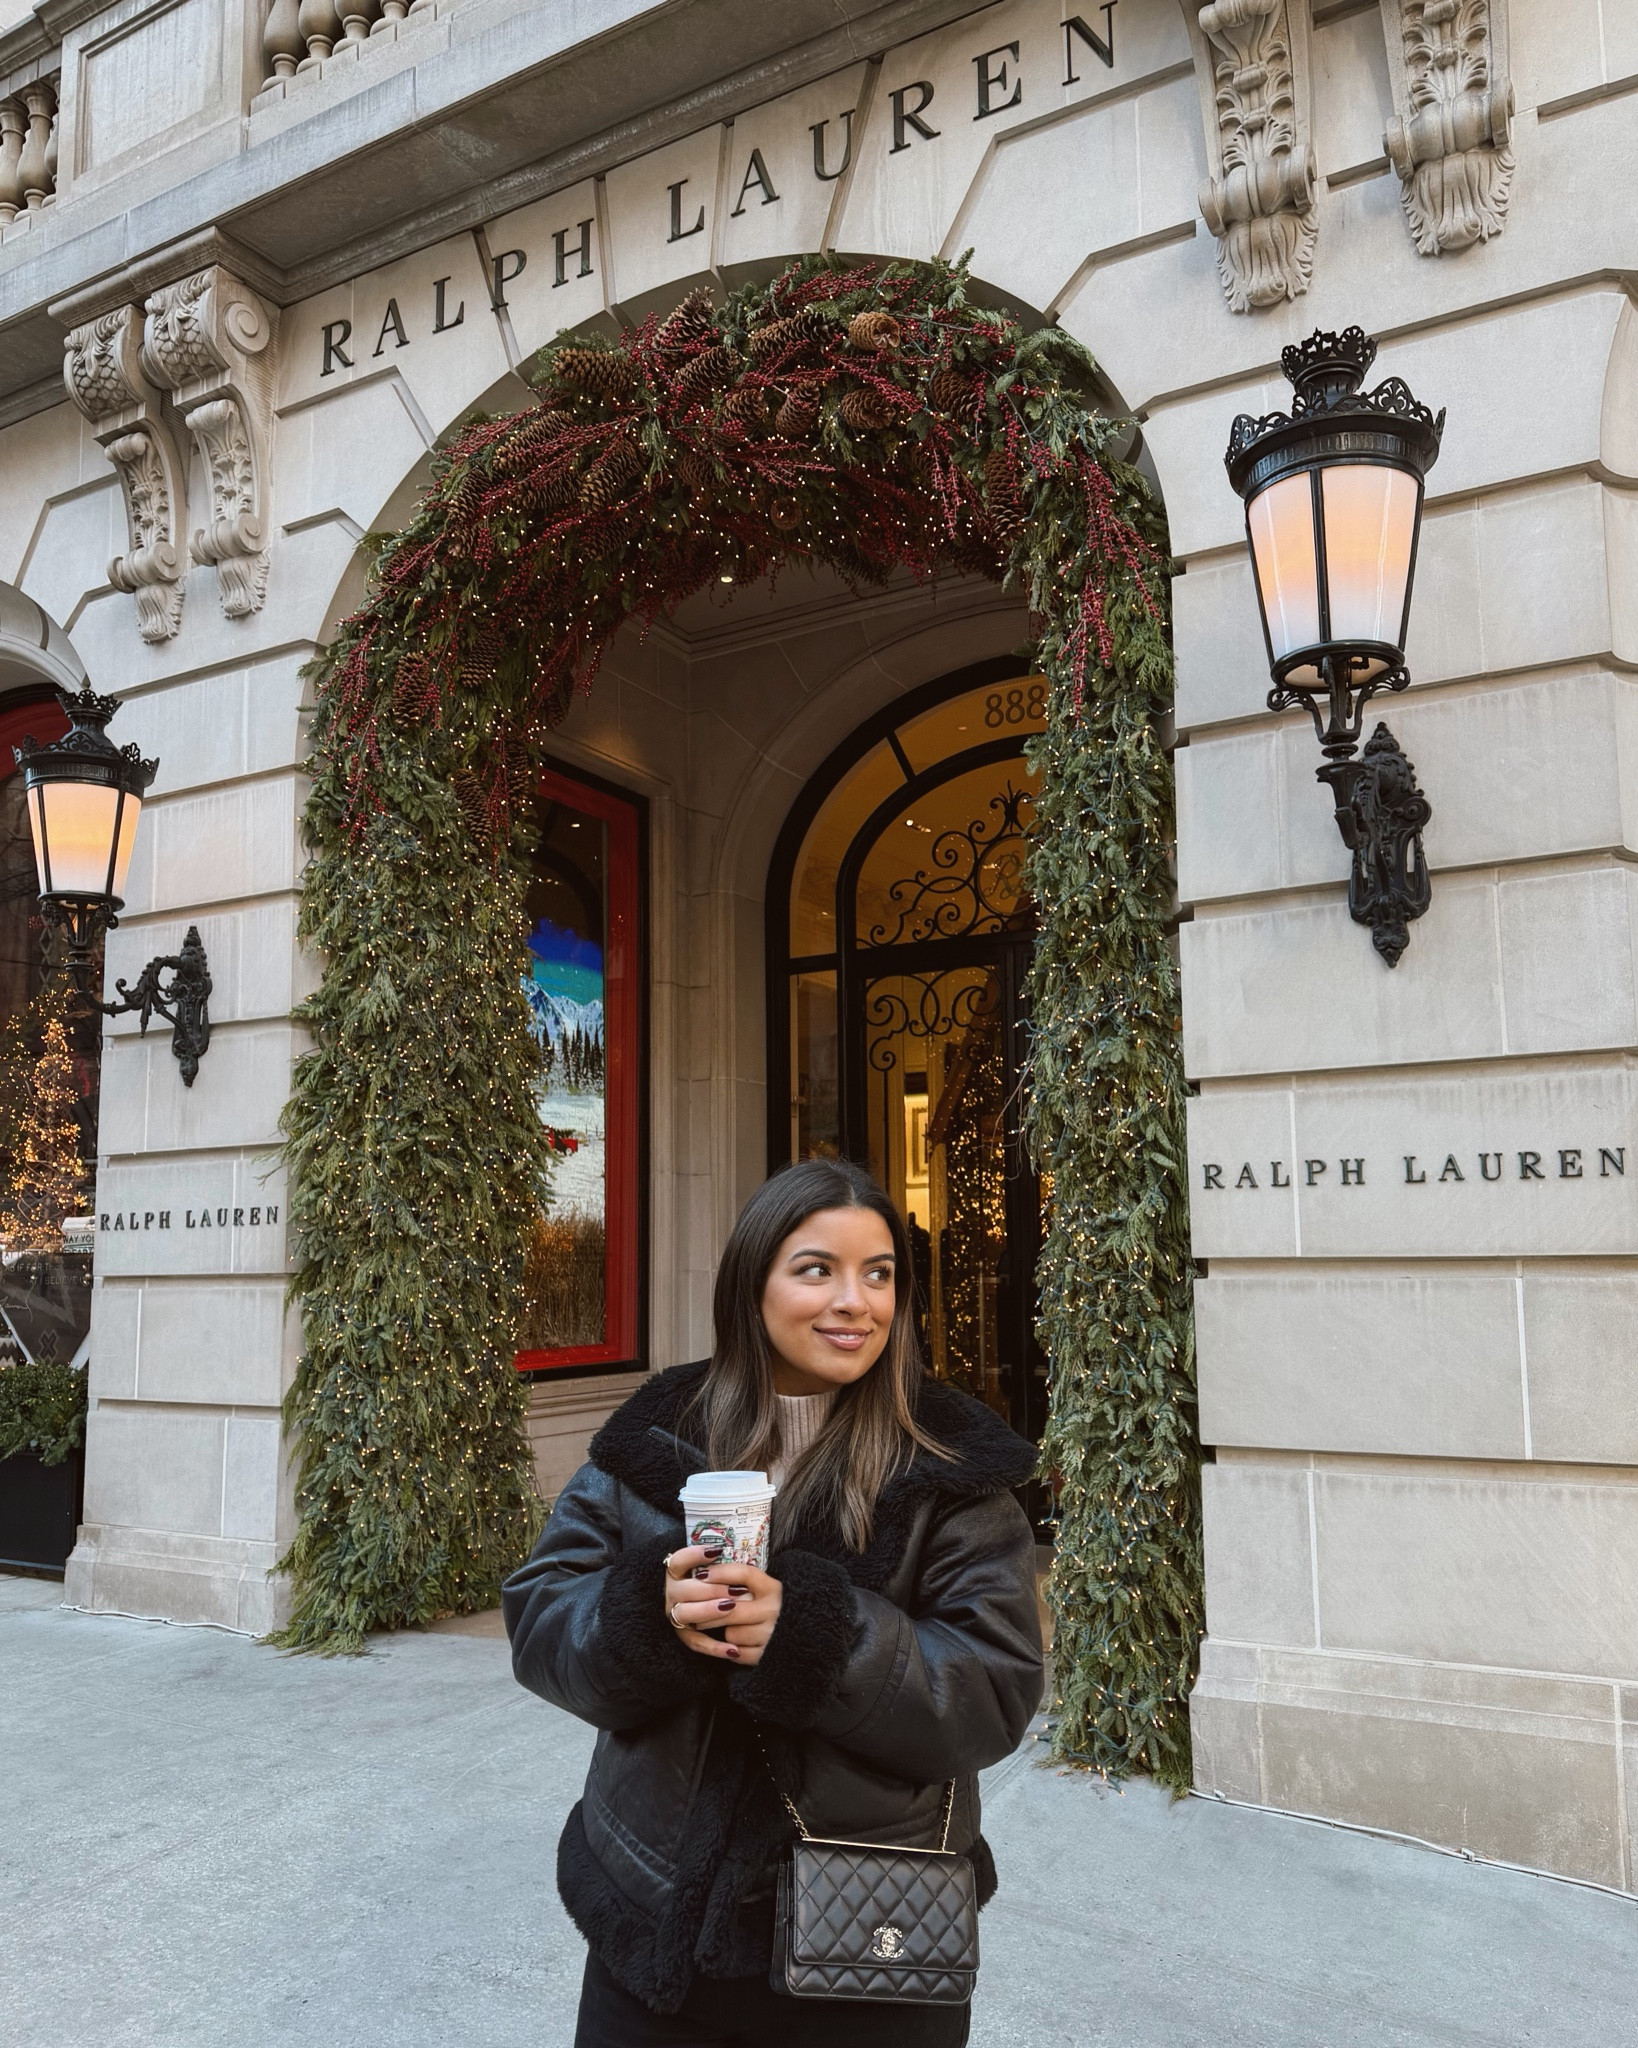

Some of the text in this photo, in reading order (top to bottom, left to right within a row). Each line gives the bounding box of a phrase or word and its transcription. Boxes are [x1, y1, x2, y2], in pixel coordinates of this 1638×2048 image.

[320, 0, 1118, 377] RALPH LAUREN
[984, 684, 1046, 729] 888
[1202, 1146, 1627, 1190] RALPH LAUREN
[99, 1206, 279, 1231] RALPH LAUREN
